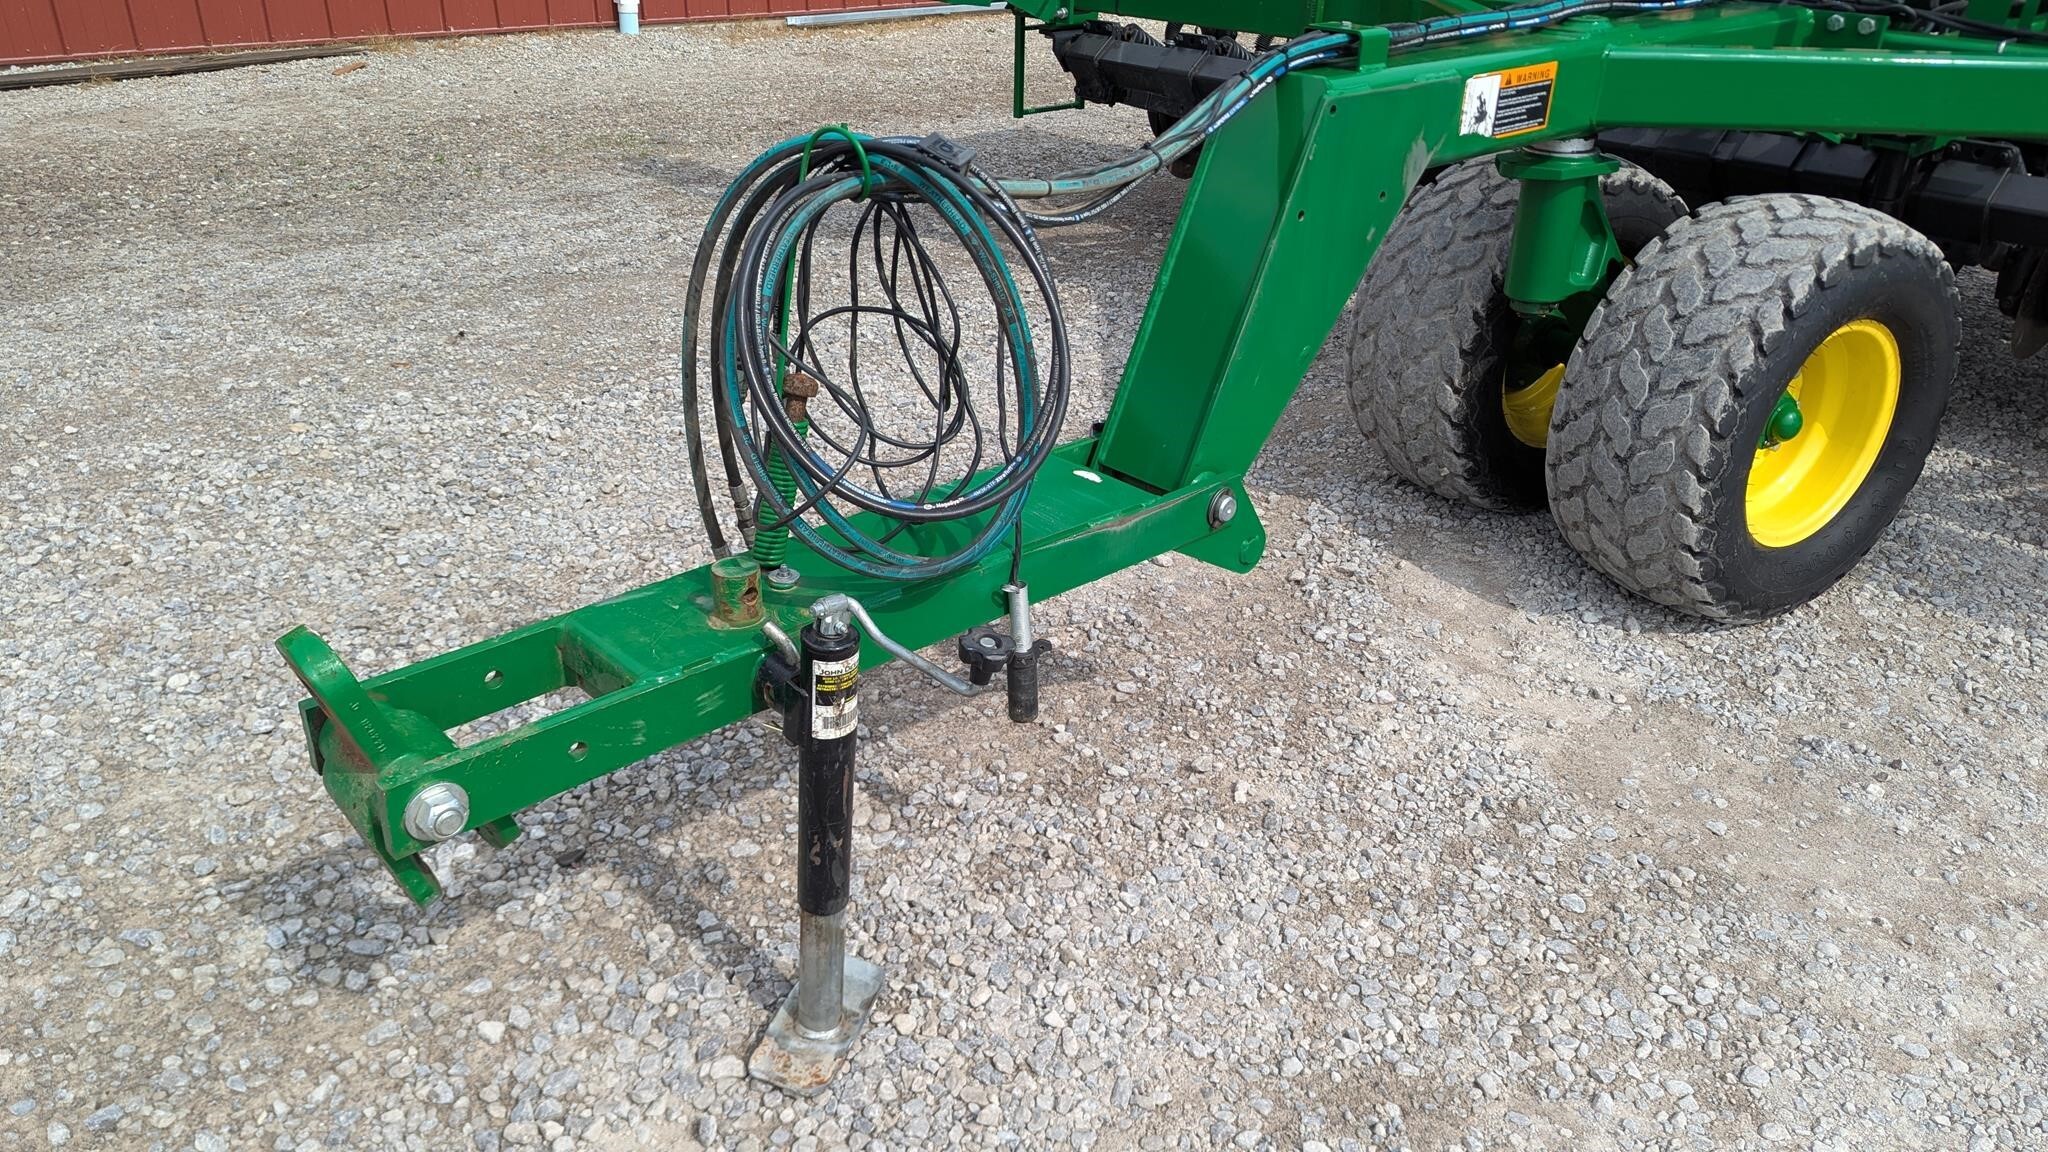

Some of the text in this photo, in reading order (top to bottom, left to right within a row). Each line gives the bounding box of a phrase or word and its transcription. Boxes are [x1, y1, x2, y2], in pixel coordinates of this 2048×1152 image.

[1516, 68, 1551, 83] WARNING
[764, 230, 794, 290] WEATHERHEAD
[797, 521, 848, 561] WEATHERHEAD
